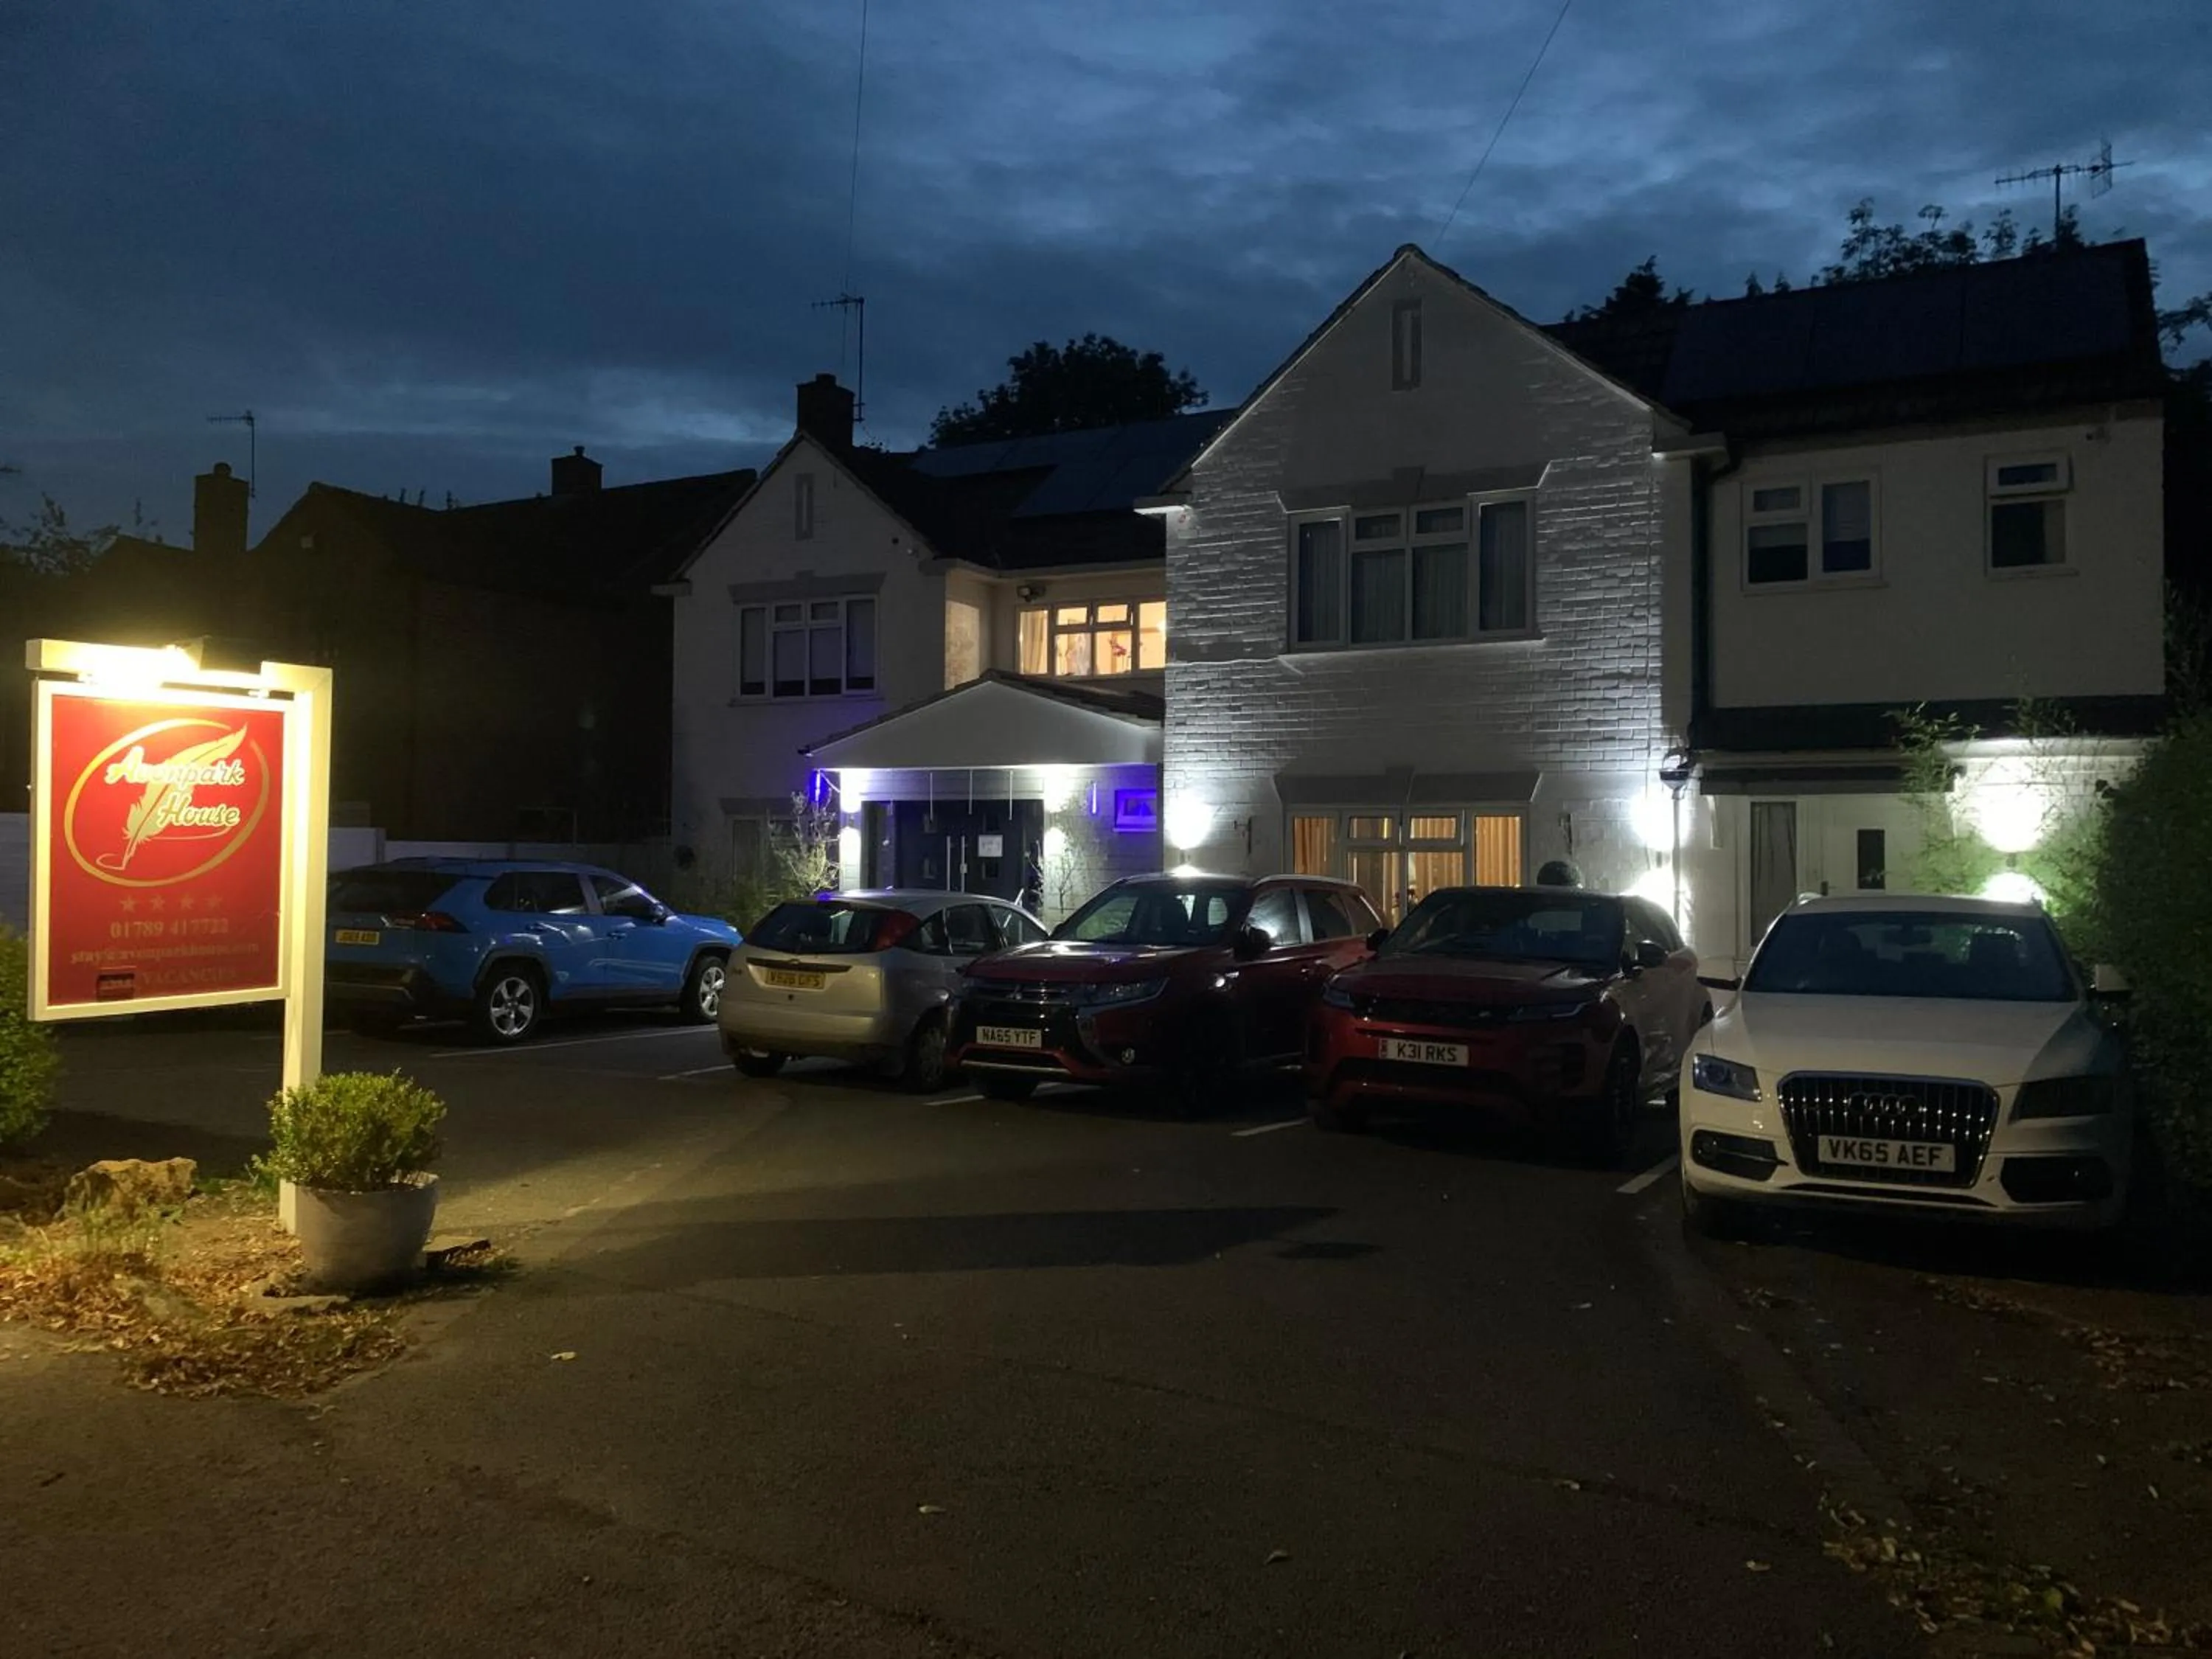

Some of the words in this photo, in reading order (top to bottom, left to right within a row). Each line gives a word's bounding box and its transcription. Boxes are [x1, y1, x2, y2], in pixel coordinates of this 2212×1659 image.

[105, 746, 245, 787] Avonpark
[157, 793, 240, 827] House
[110, 921, 164, 938] 01789
[982, 1028, 1010, 1042] NA65
[1015, 1031, 1036, 1045] YTF
[1426, 1046, 1457, 1062] RKS
[1829, 1138, 1888, 1162] VK65
[1896, 1144, 1942, 1166] AEF
